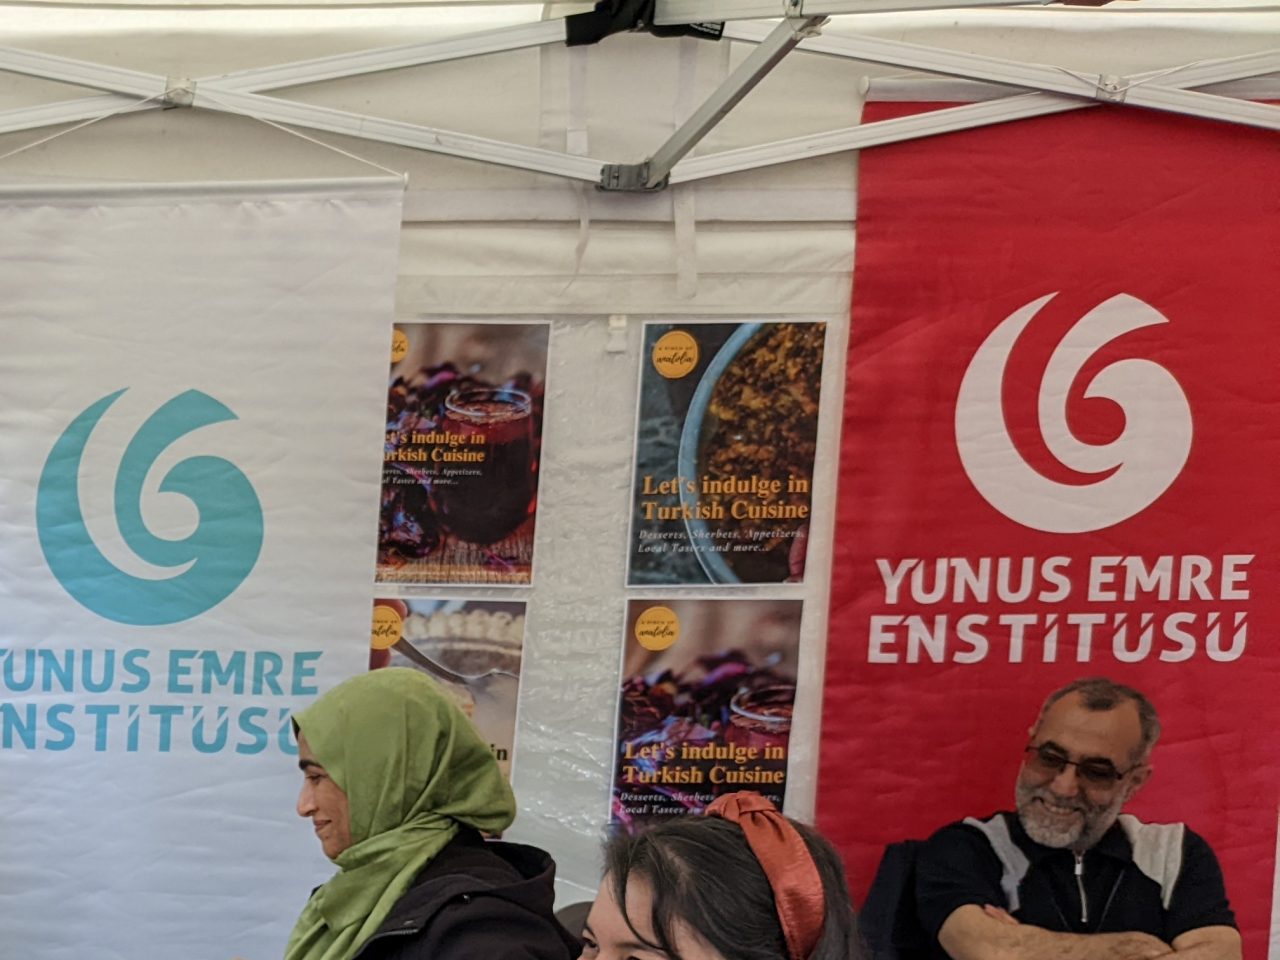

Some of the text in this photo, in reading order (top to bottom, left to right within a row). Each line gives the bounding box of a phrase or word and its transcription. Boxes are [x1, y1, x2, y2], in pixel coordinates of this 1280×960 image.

[385, 430, 486, 447] et's indulge in
[383, 447, 486, 462] urkish Cuisine
[641, 474, 809, 498] Let's indulge in
[641, 499, 809, 520] Turkish Cuisine
[638, 543, 668, 553] Local
[708, 542, 732, 553] and
[875, 553, 1257, 605] YUNUS EMRE
[166, 648, 324, 697] EMRE
[623, 741, 785, 764] Let's indulge in
[622, 765, 785, 785] Turkish Cuisine
[671, 792, 715, 802] Sherbets
[620, 804, 647, 814] Local
[651, 804, 684, 814] Tastes
